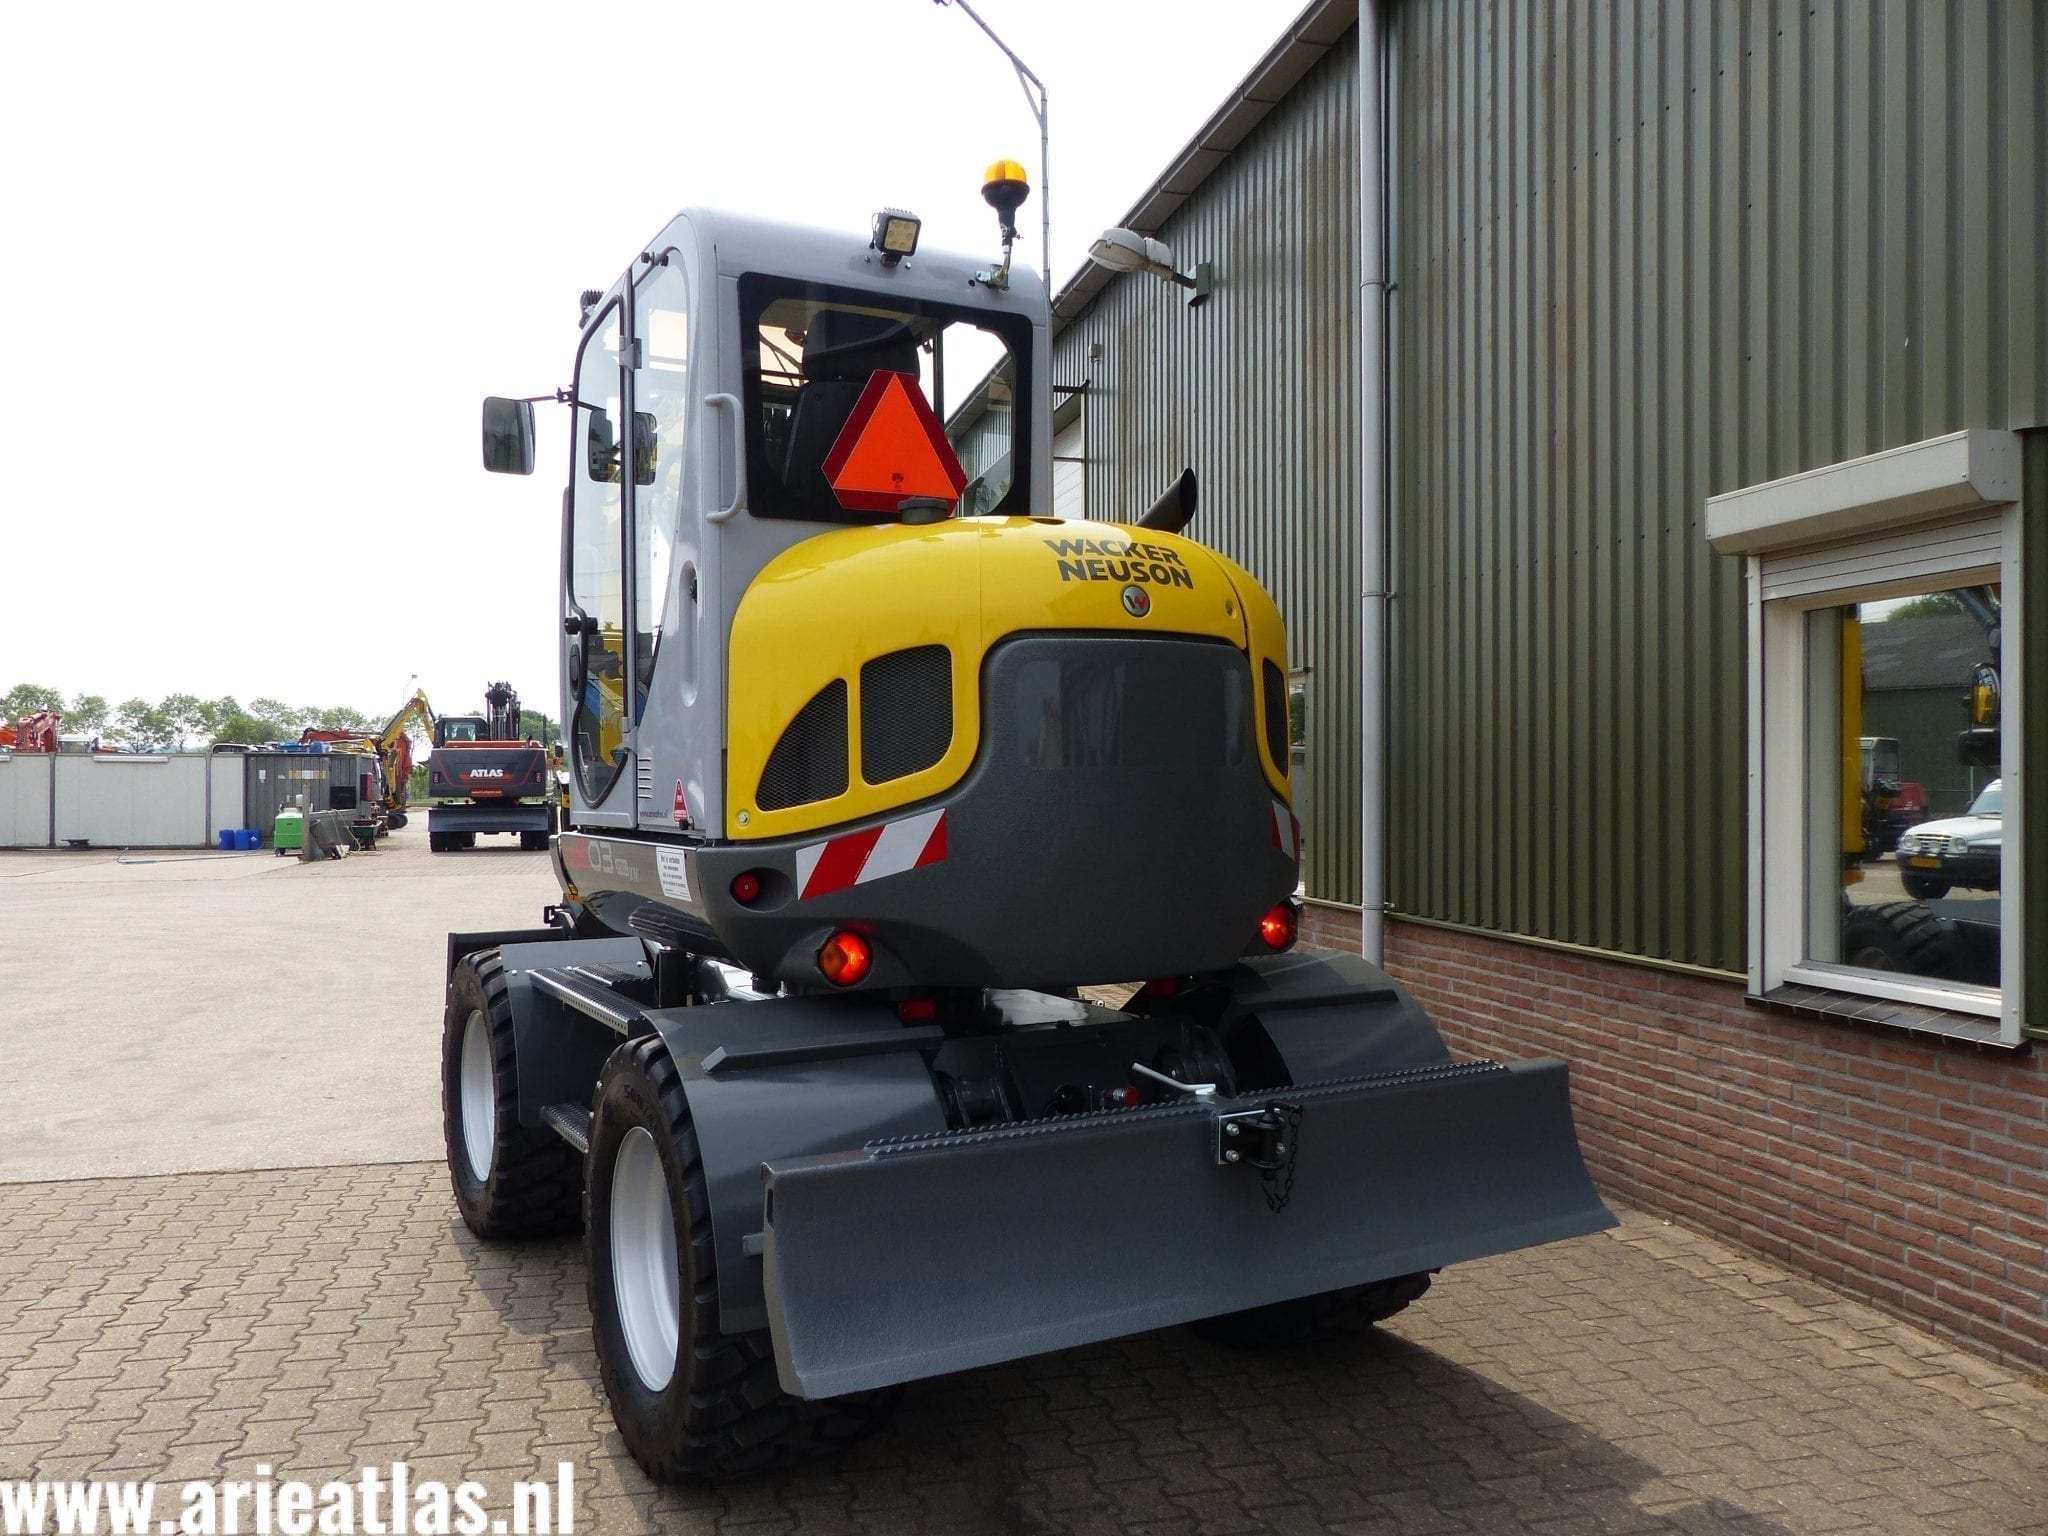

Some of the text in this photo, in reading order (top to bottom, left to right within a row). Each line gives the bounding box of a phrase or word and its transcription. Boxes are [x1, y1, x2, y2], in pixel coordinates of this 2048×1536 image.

[1043, 539, 1184, 566] WACKER
[1057, 559, 1193, 589] NEUSON
[470, 768, 504, 778] ATLAS
